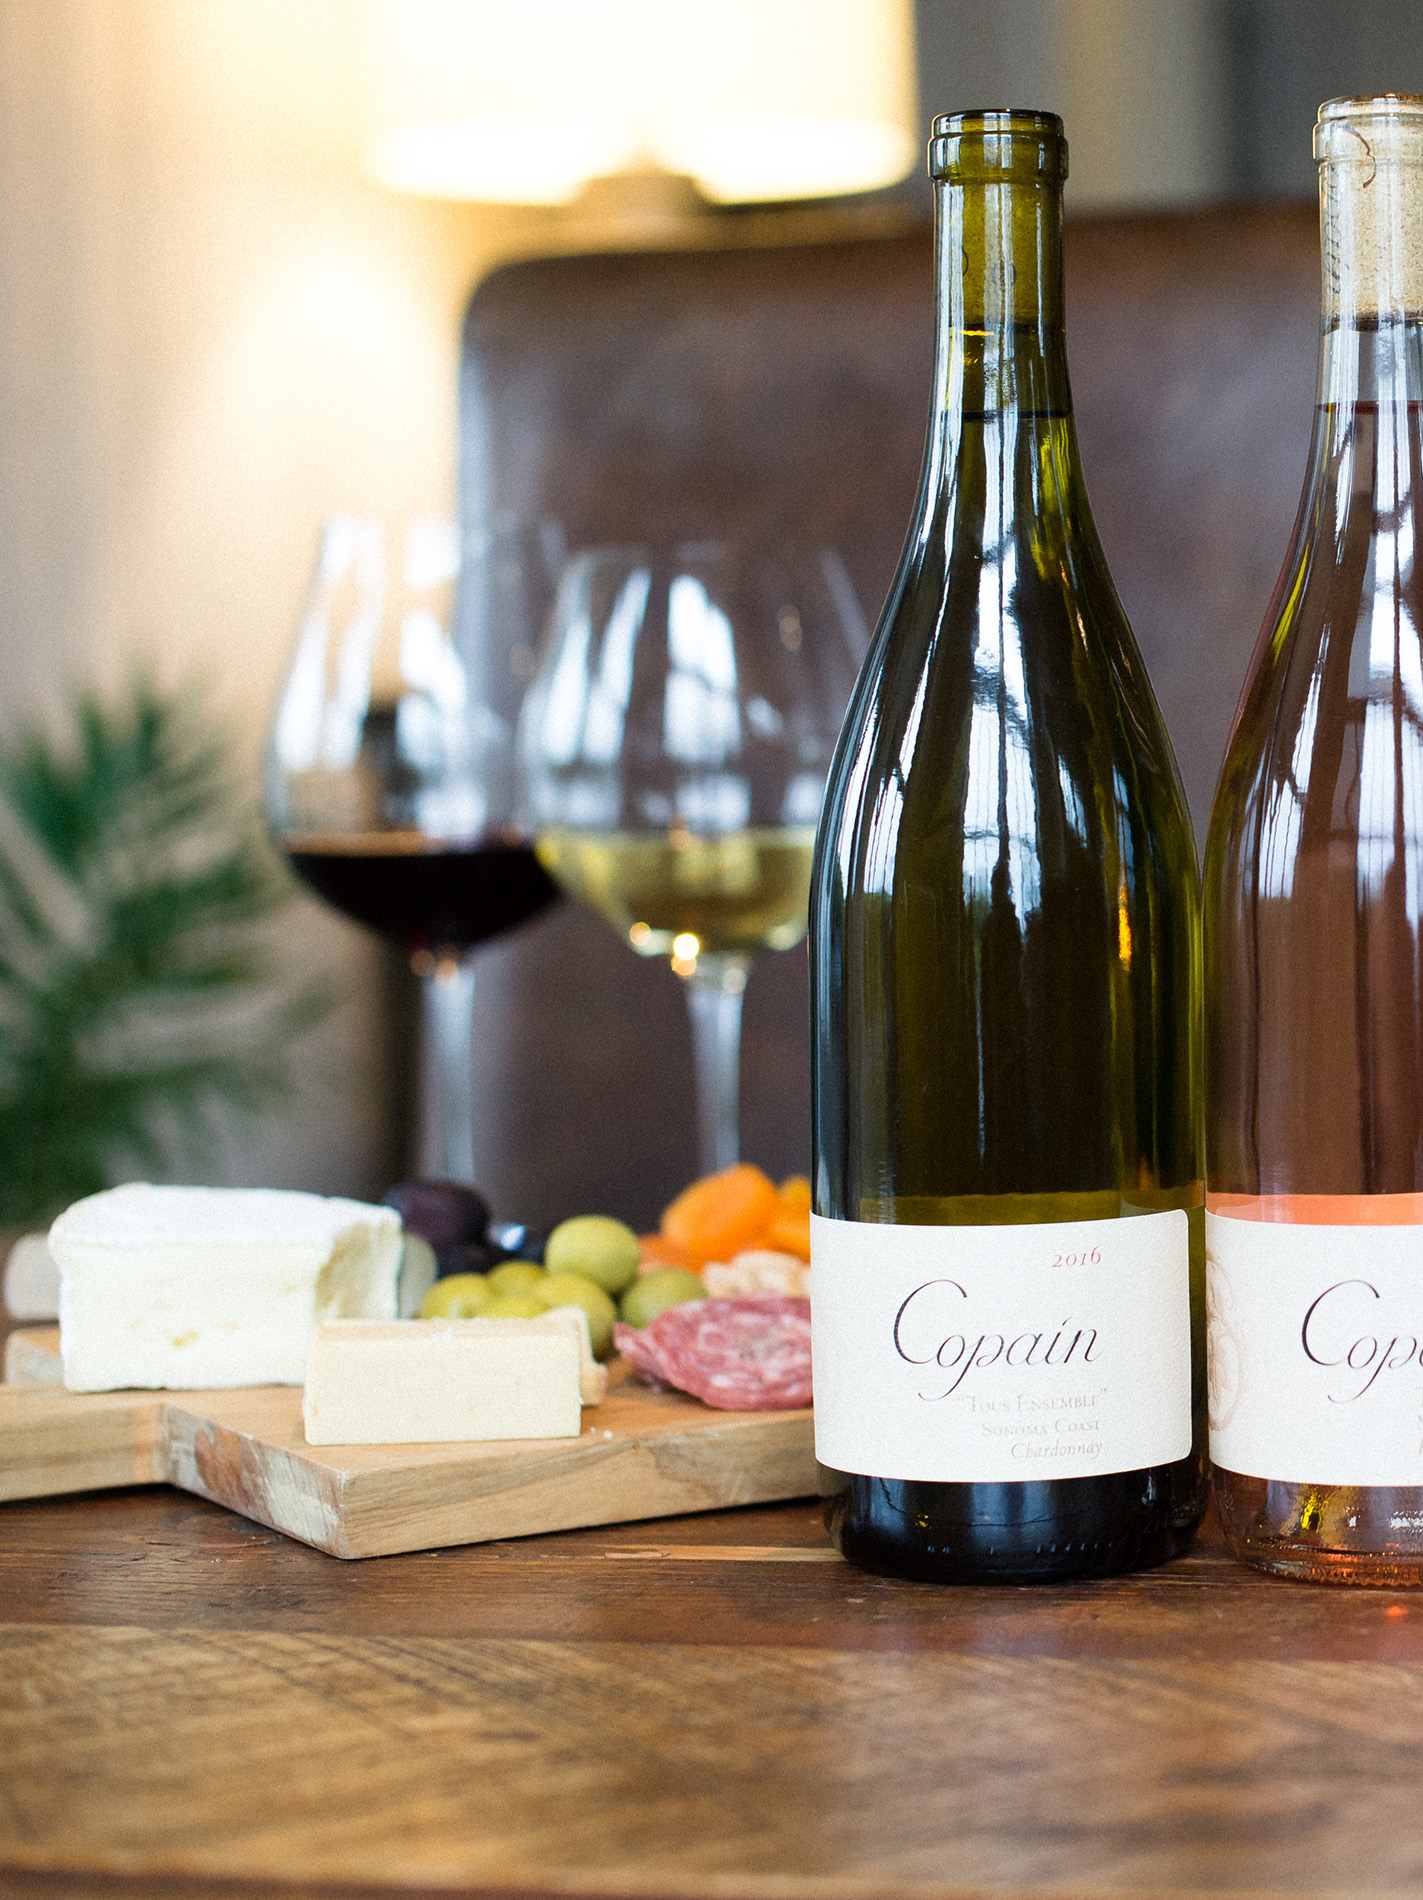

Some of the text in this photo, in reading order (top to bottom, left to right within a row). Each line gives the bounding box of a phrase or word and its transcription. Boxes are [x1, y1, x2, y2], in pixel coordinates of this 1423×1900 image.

[1052, 1245, 1102, 1268] 2016
[893, 1279, 1103, 1401] Copain
[1010, 1438, 1103, 1461] Chardonnay
